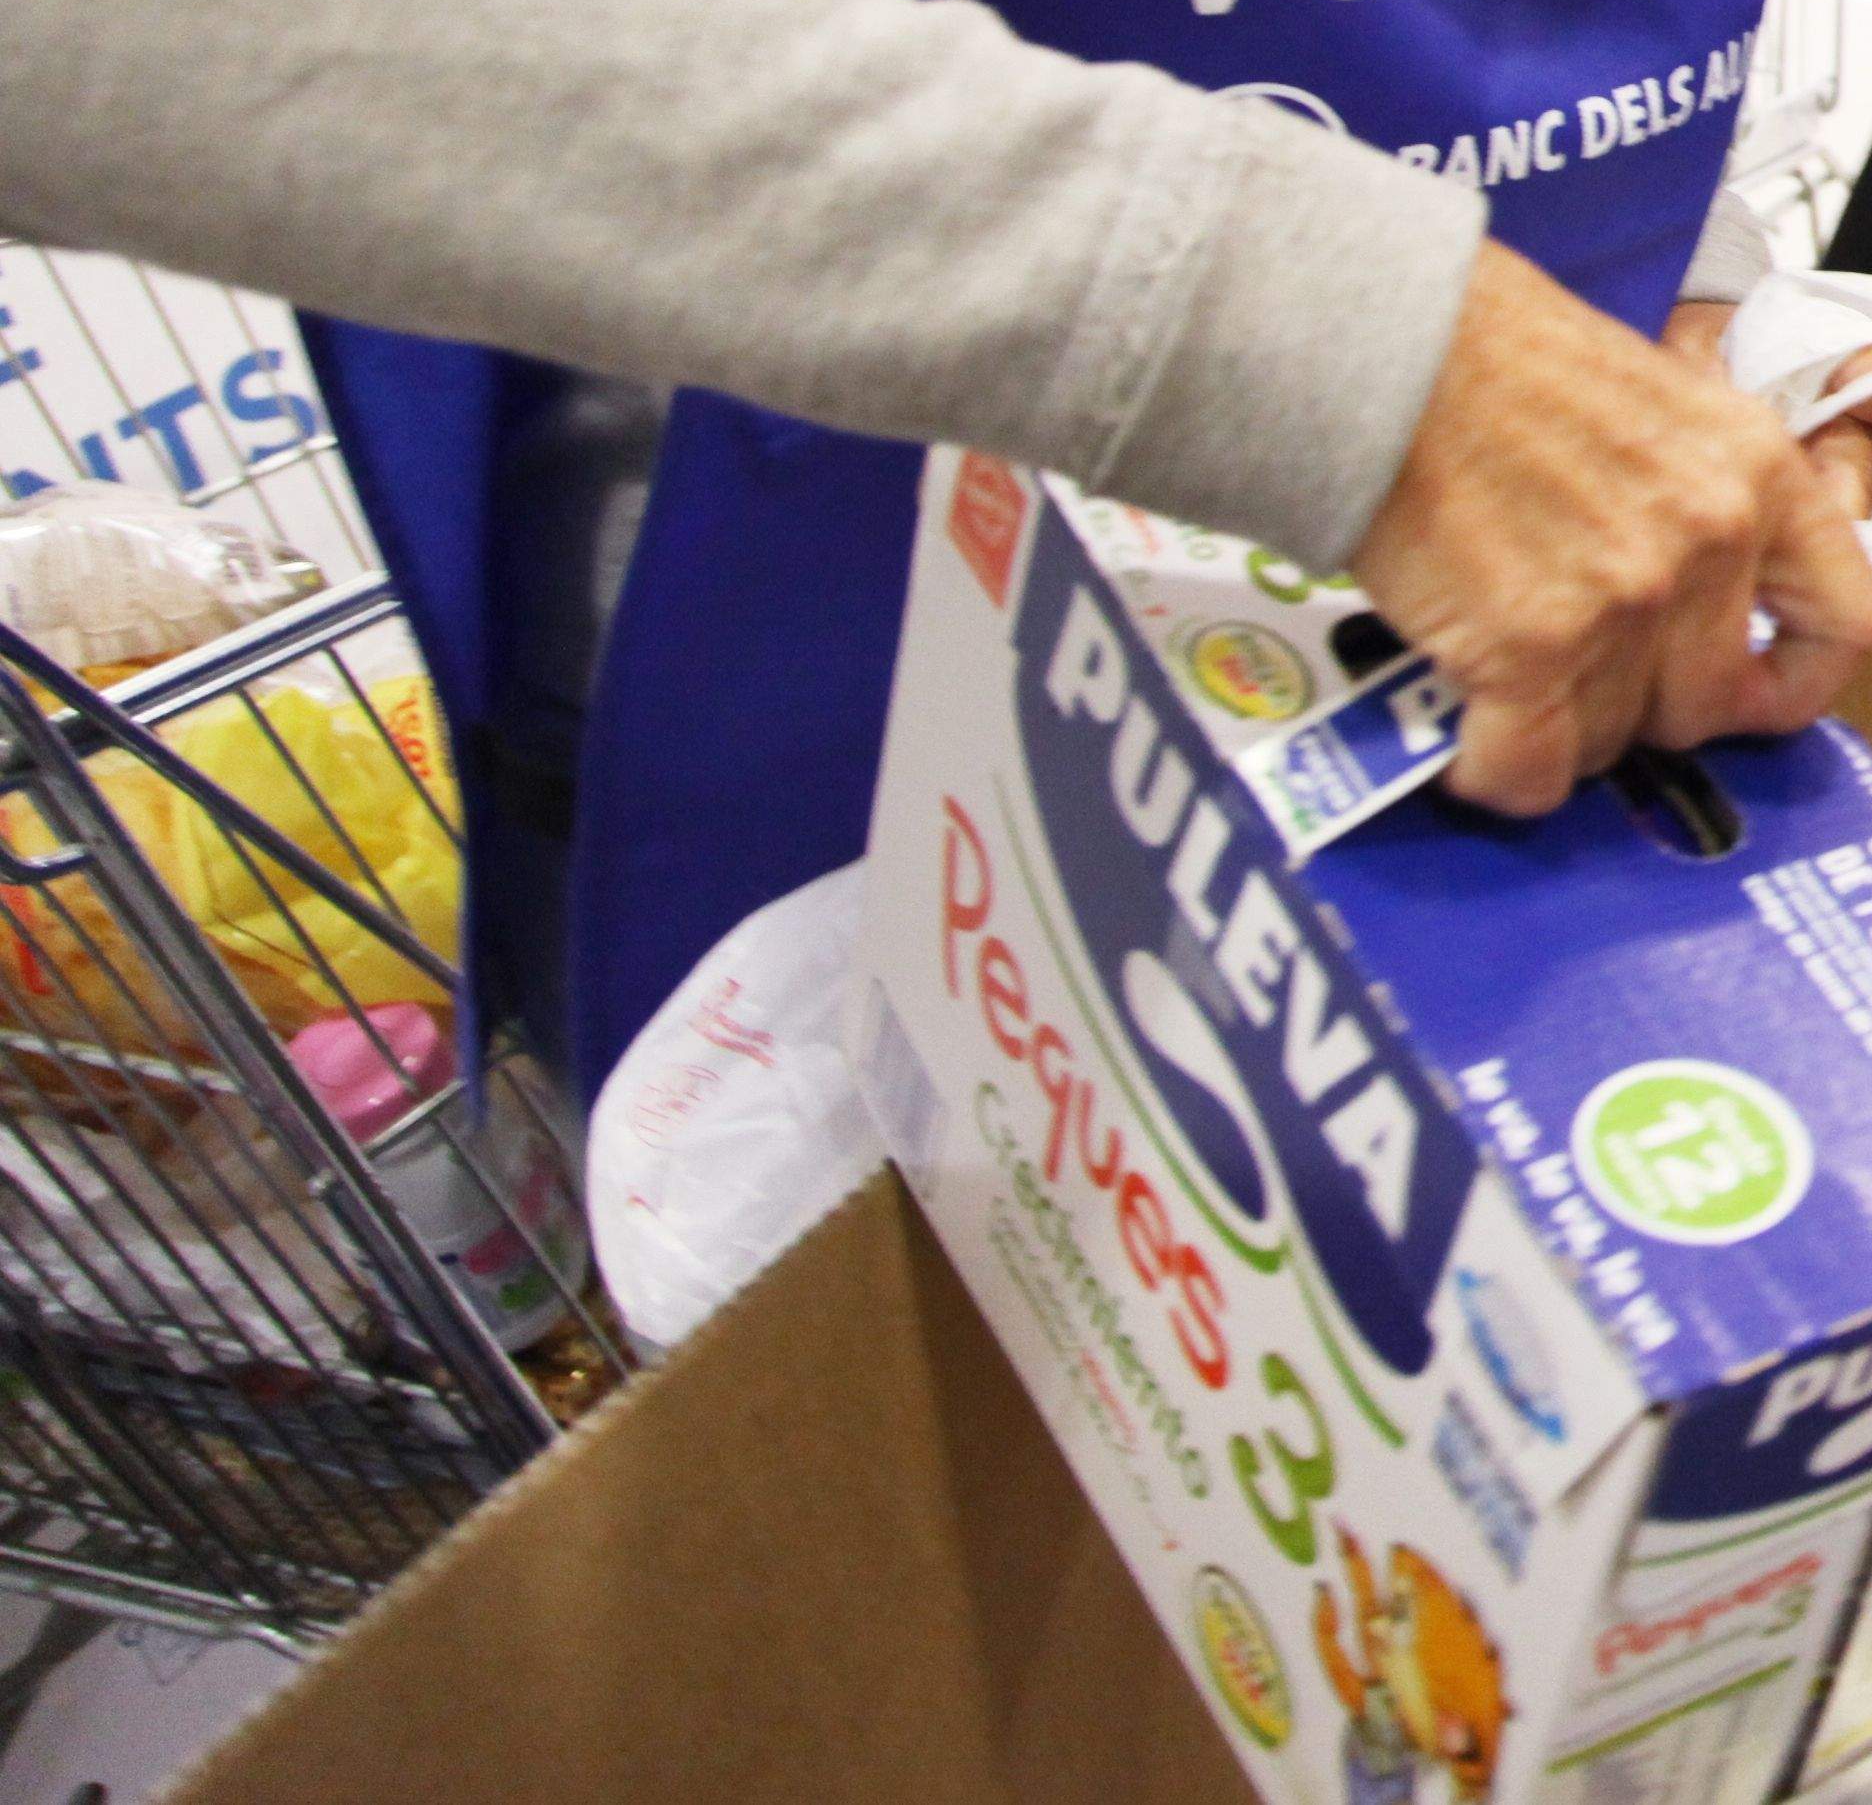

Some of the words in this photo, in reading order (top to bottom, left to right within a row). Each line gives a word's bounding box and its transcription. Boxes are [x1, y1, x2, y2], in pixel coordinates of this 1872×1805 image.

[1578, 64, 1696, 160] DELS
[942, 794, 1232, 1391] Peques
[1229, 1352, 1338, 1565] 3
[1044, 587, 1420, 1244] PULEVA
